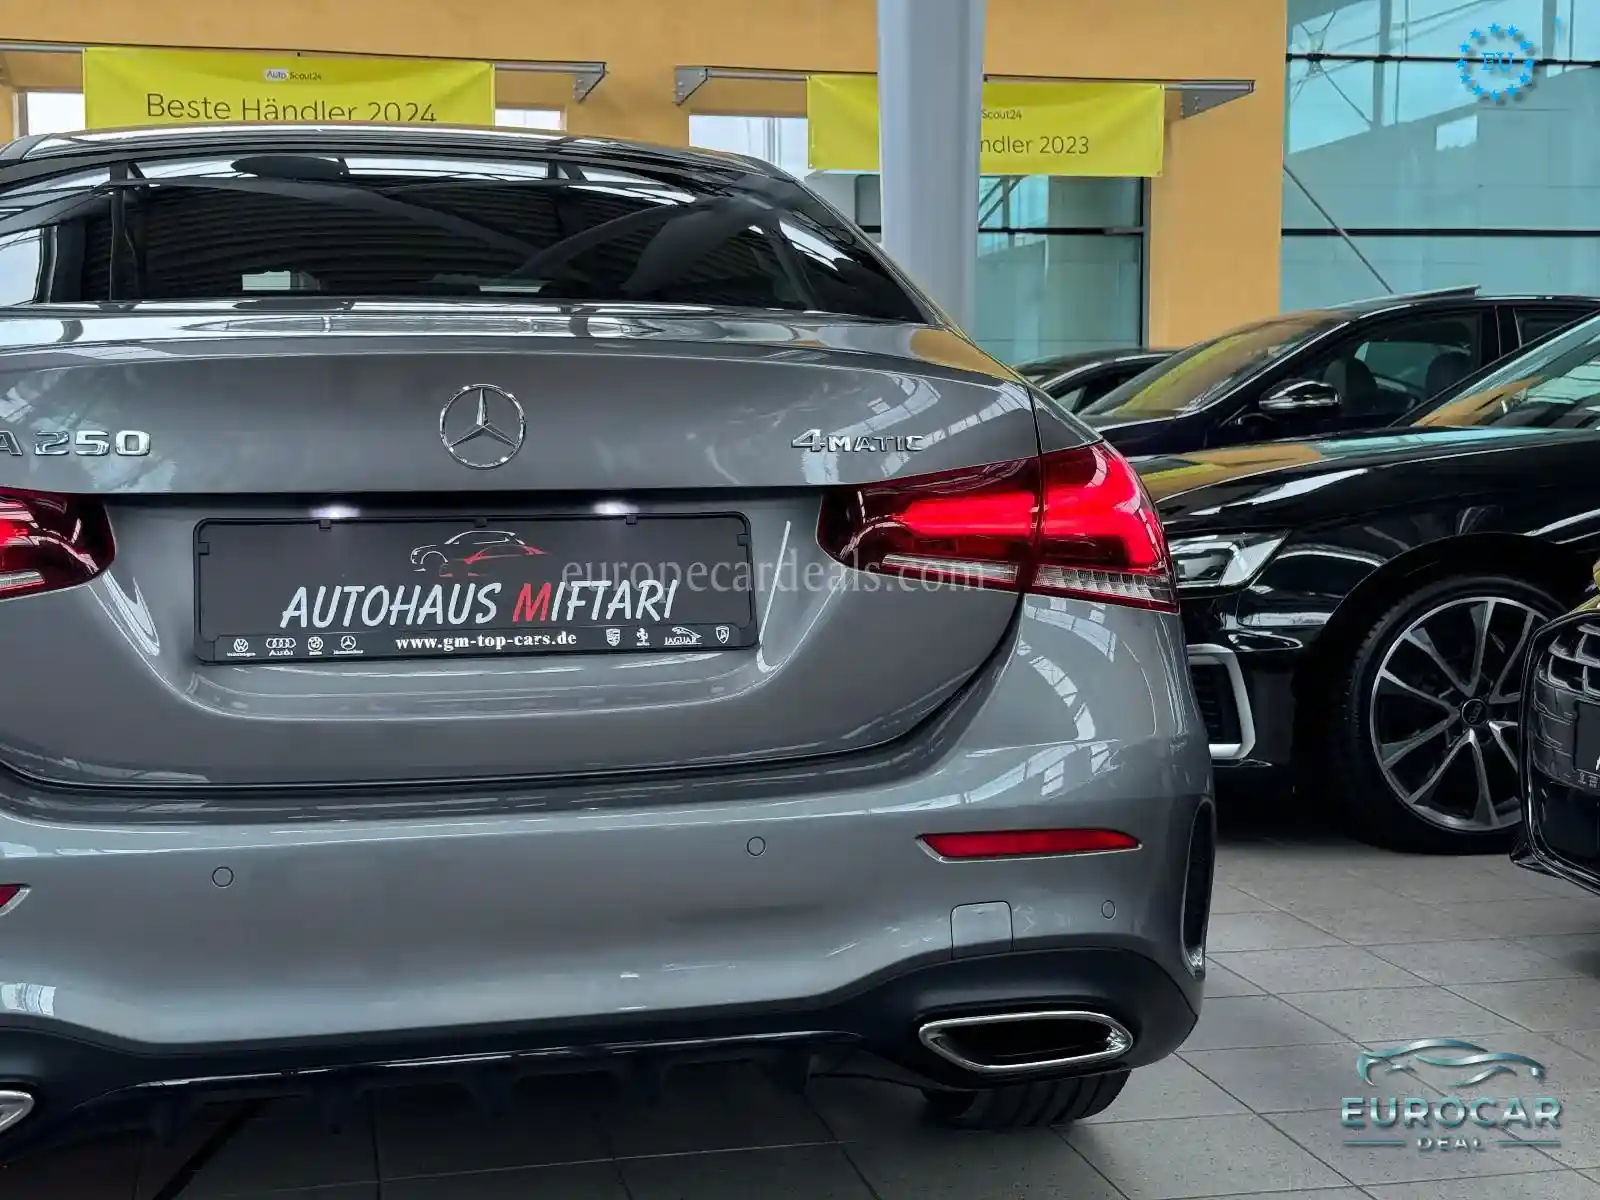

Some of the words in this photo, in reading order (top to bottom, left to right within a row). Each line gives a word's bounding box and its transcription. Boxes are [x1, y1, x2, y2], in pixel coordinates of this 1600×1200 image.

[147, 92, 231, 119] Beste
[242, 97, 358, 120] Händler
[368, 101, 437, 121] 2024
[980, 136, 1033, 153] ndler
[1039, 136, 1089, 154] 2023
[34, 429, 151, 456] 250
[791, 428, 925, 452] 4MATIC
[279, 582, 502, 629] AUTOHAUS
[512, 579, 678, 622] MIFTARI
[395, 631, 577, 652] www.gm-top-cars.de
